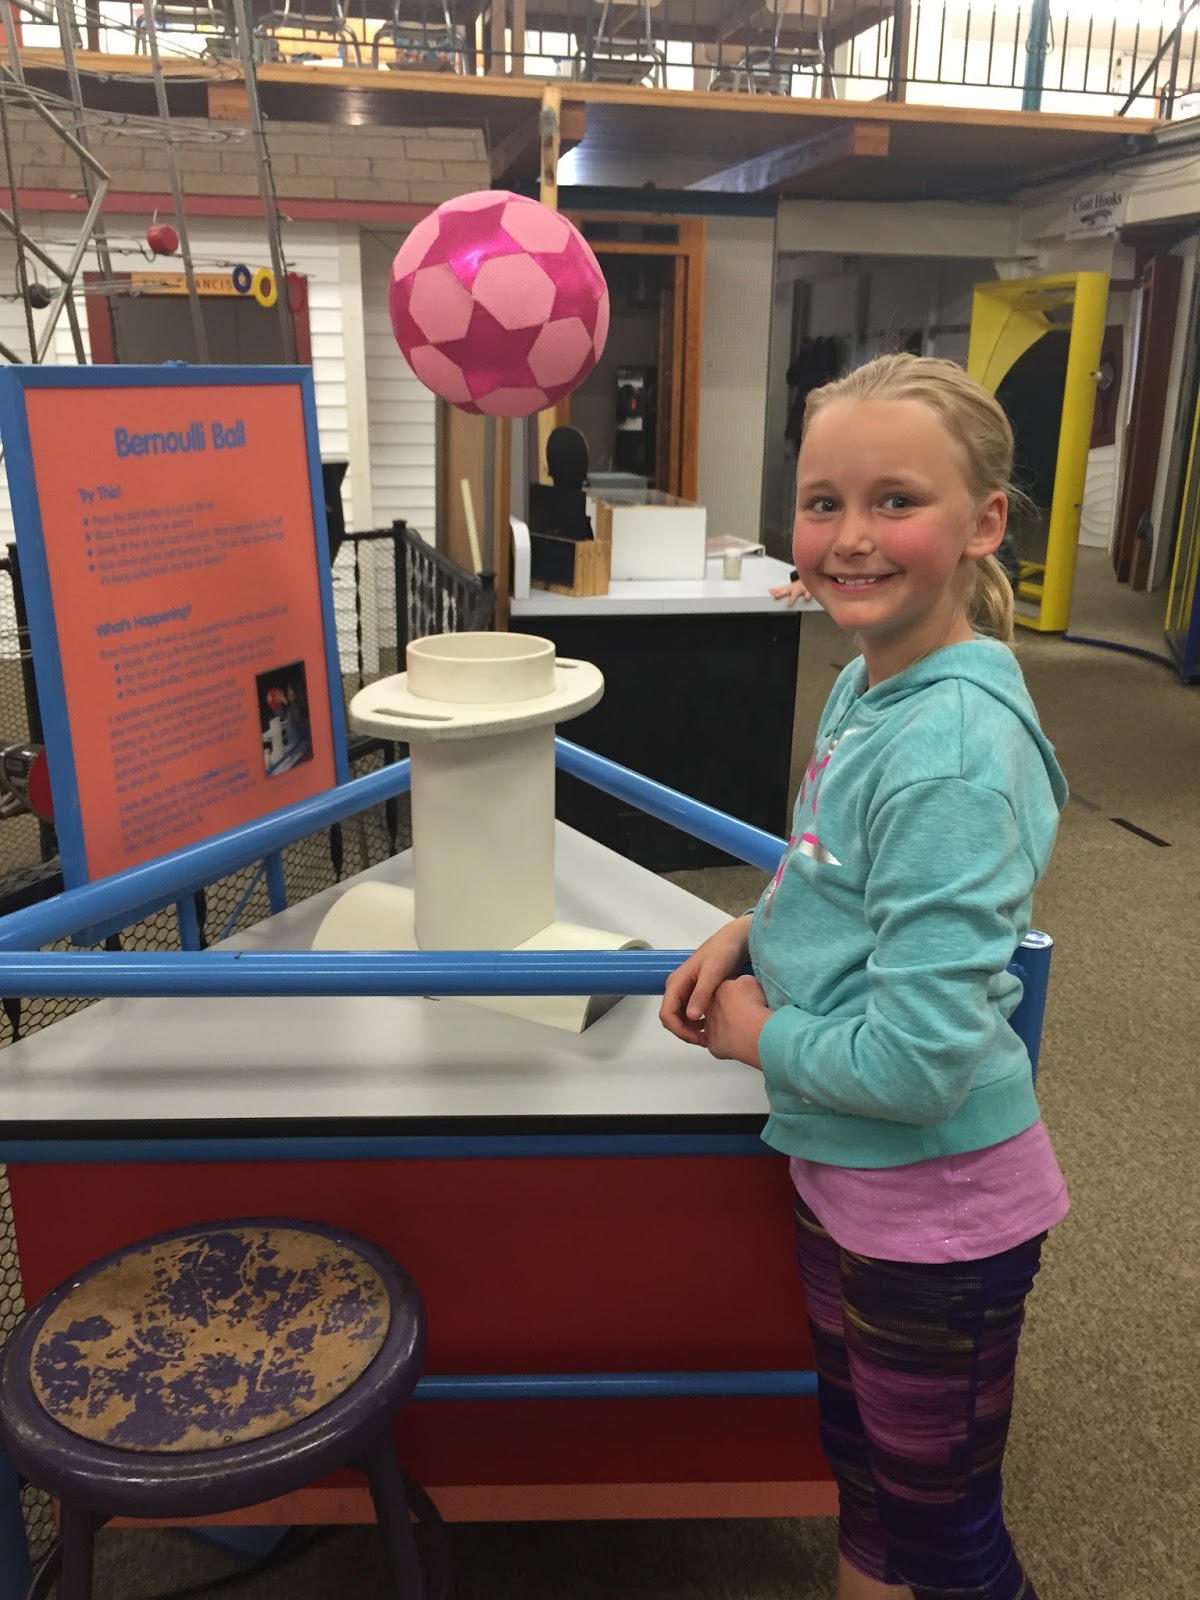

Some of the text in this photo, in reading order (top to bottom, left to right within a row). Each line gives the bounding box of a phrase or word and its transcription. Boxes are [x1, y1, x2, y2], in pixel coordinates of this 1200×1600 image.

[1073, 191, 1122, 212] Coat Hooks
[114, 419, 247, 458] Bernoulli Ball
[79, 488, 95, 505] Try
[96, 619, 132, 637] What's
[134, 603, 193, 628] Happening?
